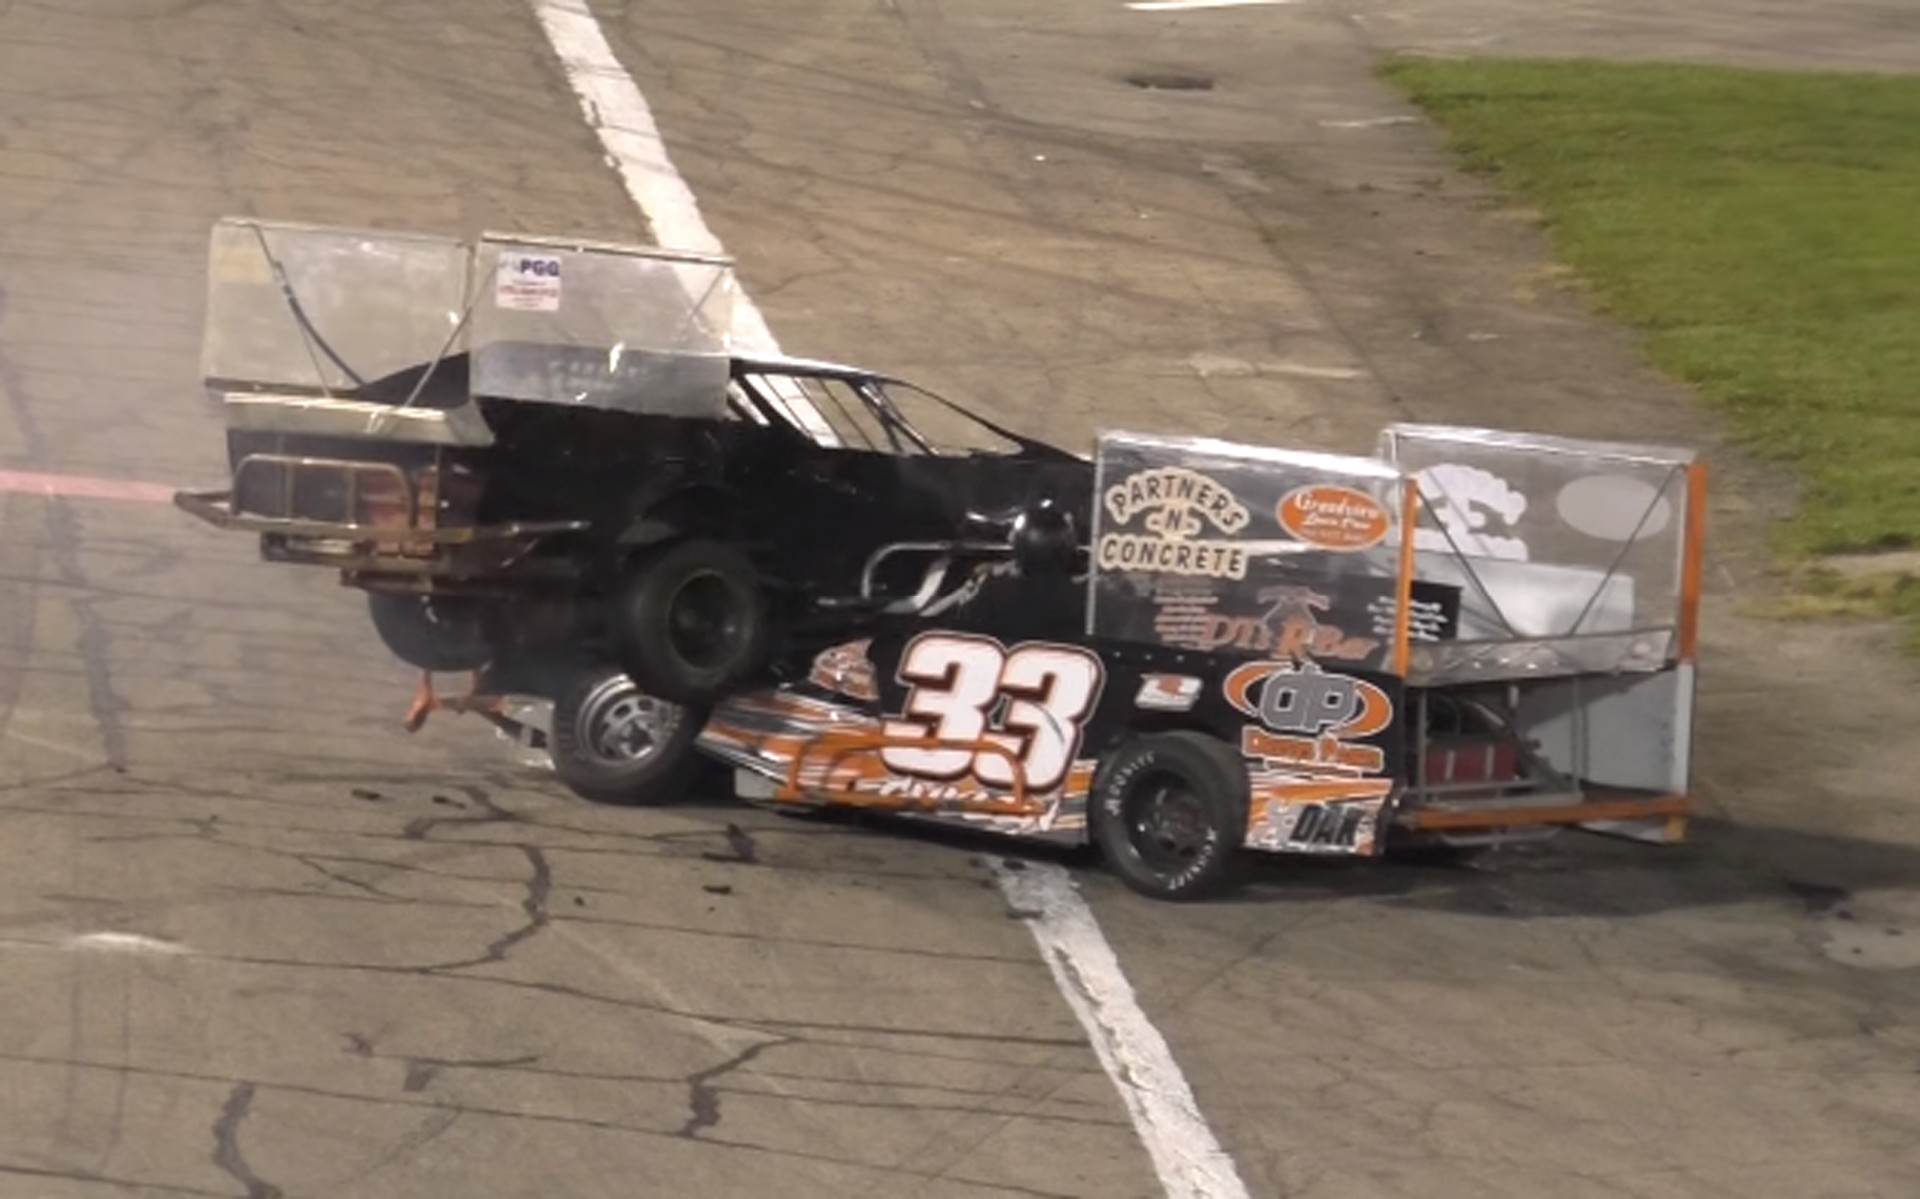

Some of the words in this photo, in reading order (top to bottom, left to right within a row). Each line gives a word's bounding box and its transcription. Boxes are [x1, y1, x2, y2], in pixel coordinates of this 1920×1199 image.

[1109, 473, 1244, 527] PARTNERS
[1102, 538, 1244, 572] CONCRETE
[881, 630, 1106, 792] 33
